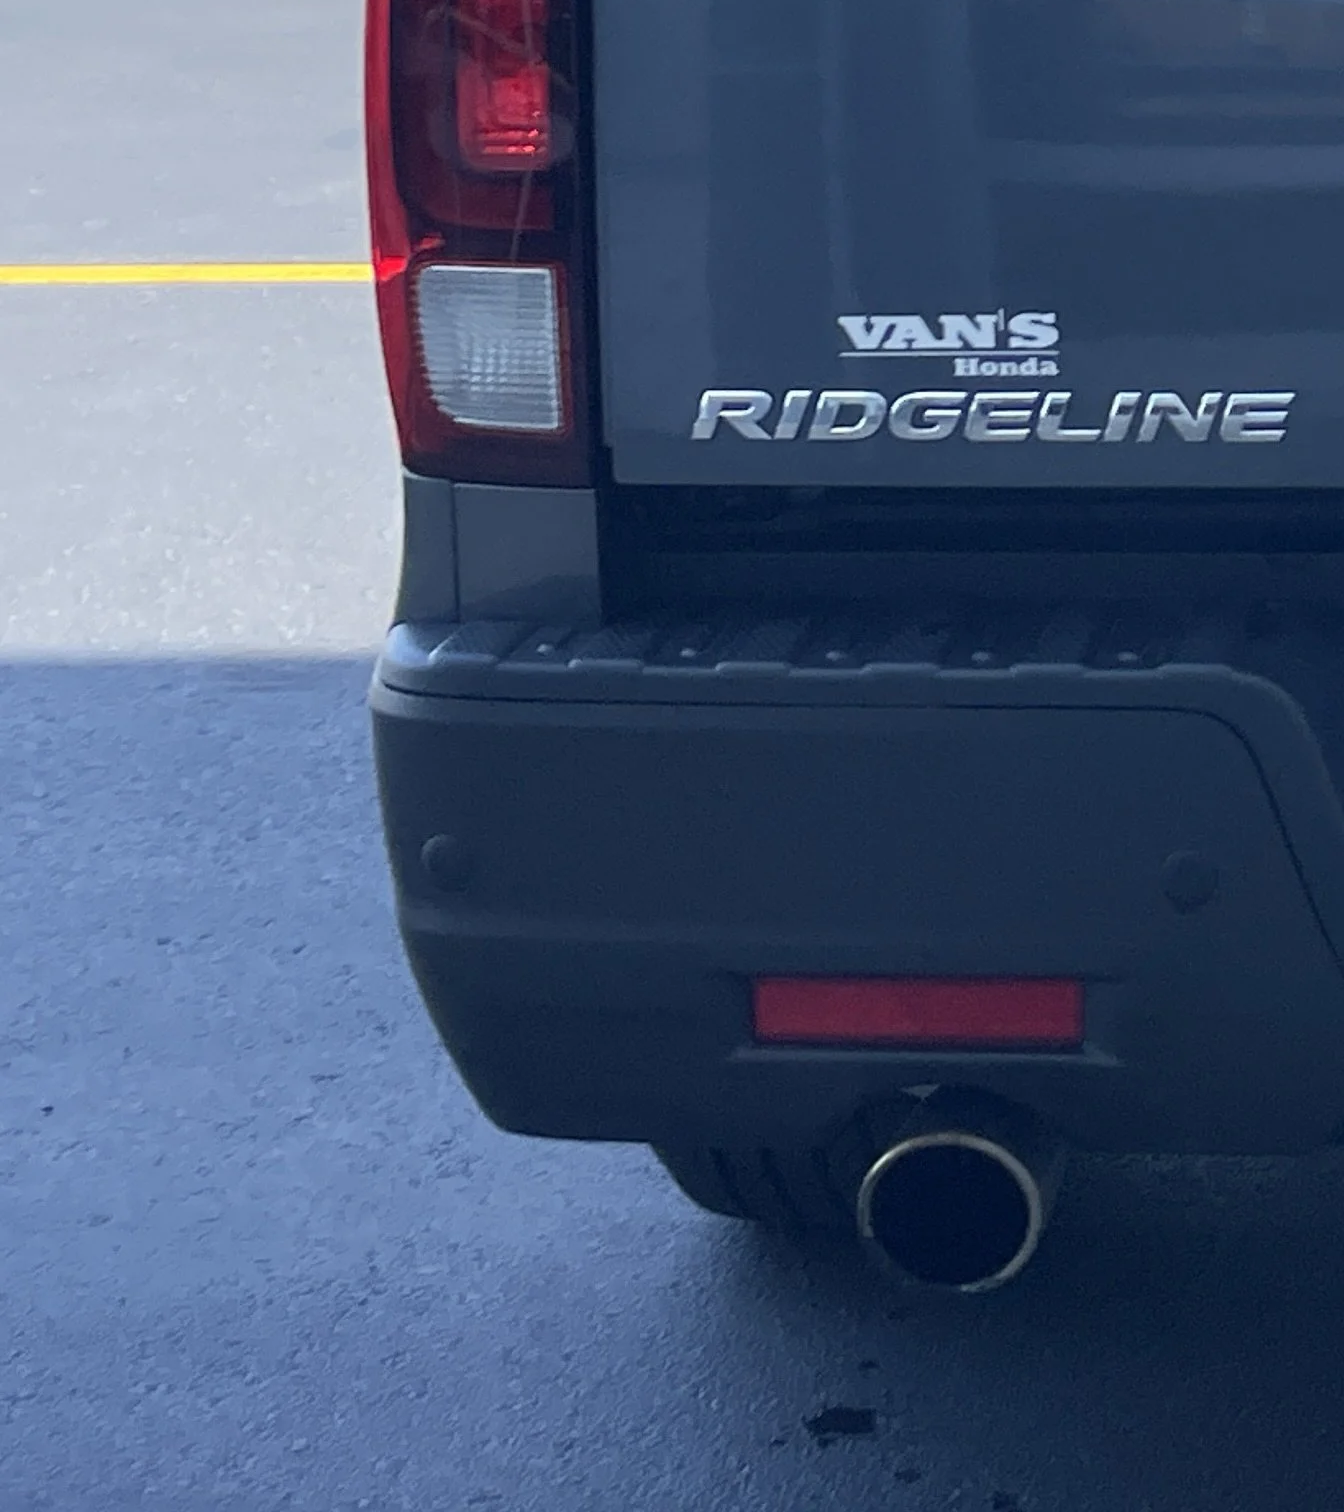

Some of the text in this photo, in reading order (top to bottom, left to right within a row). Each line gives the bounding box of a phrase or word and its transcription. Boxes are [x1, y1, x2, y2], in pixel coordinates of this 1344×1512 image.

[837, 308, 1061, 352] VAN'S
[953, 357, 1060, 377] Honda
[690, 390, 1296, 443] RIDGELINE
